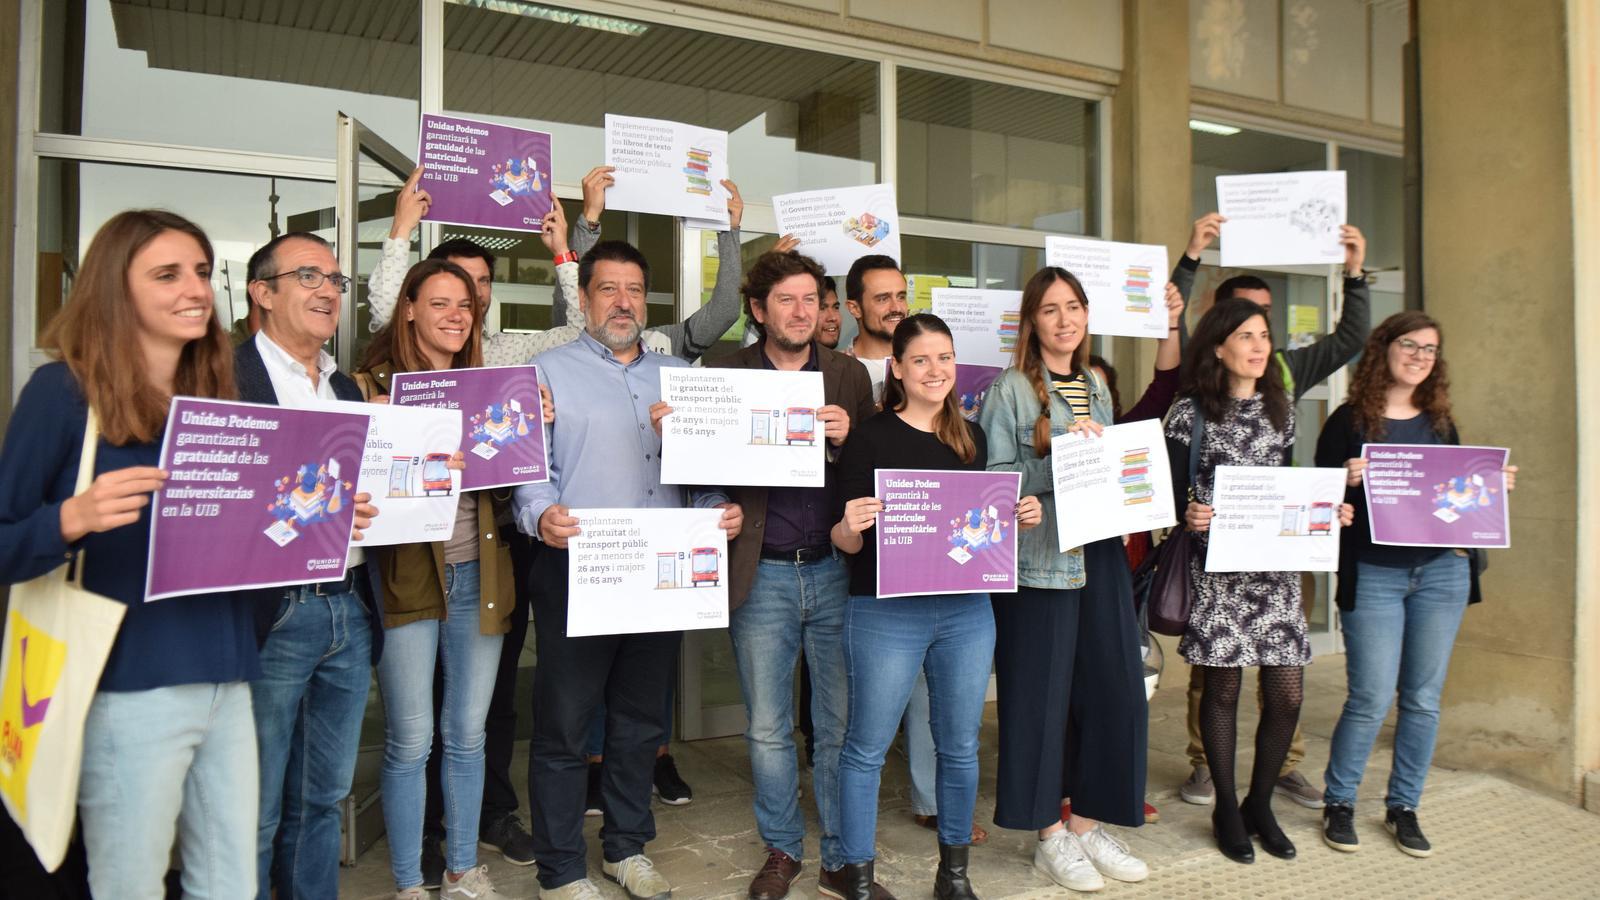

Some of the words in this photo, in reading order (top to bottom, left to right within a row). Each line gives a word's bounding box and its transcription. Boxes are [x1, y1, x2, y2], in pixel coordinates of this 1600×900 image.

[428, 120, 454, 131] Unidas
[456, 125, 488, 136] Podemos
[426, 133, 469, 143] garantizará
[426, 142, 463, 152] gratuidad
[475, 147, 485, 155] las
[425, 152, 466, 163] matrículas
[424, 162, 478, 174] universitarias
[444, 174, 458, 182] UIB
[784, 222, 816, 230] viviendas
[669, 373, 725, 383] Implantarem
[402, 381, 430, 390] Unides
[431, 379, 457, 388] Podem
[670, 395, 712, 404] transport
[715, 395, 742, 404] públic
[728, 405, 738, 414] de
[181, 411, 227, 427] Unidas
[228, 415, 279, 430] Podemos
[683, 417, 703, 425] anys
[710, 416, 739, 426] majors
[369, 426, 378, 436] el
[695, 428, 716, 437] anys
[176, 433, 246, 446] garantizará
[249, 434, 259, 446] la
[366, 439, 392, 449] úblico
[173, 450, 237, 465] gratuidad
[238, 452, 251, 464] de
[252, 452, 269, 464] las
[372, 453, 382, 462] de
[171, 468, 239, 482] matrículas
[362, 468, 388, 477] ayores
[886, 479, 913, 488] Unides
[914, 480, 940, 488] Podem
[166, 486, 254, 499] universitarias
[922, 490, 928, 499] la
[162, 507, 177, 517] en
[180, 504, 192, 517] la
[195, 504, 220, 517] UIB
[921, 502, 930, 510] de
[932, 502, 942, 510] les
[580, 517, 632, 527] mplantarem
[884, 513, 926, 522] matrícules
[587, 528, 626, 539] gratuïtat
[628, 528, 640, 536] del
[578, 541, 620, 550] transport
[622, 539, 648, 550] públic
[890, 536, 896, 545] la
[898, 536, 912, 545] UIB
[578, 554, 592, 562] per
[634, 551, 644, 559] de
[617, 563, 646, 573] majors
[577, 576, 588, 584] de
[601, 577, 622, 585] anys
